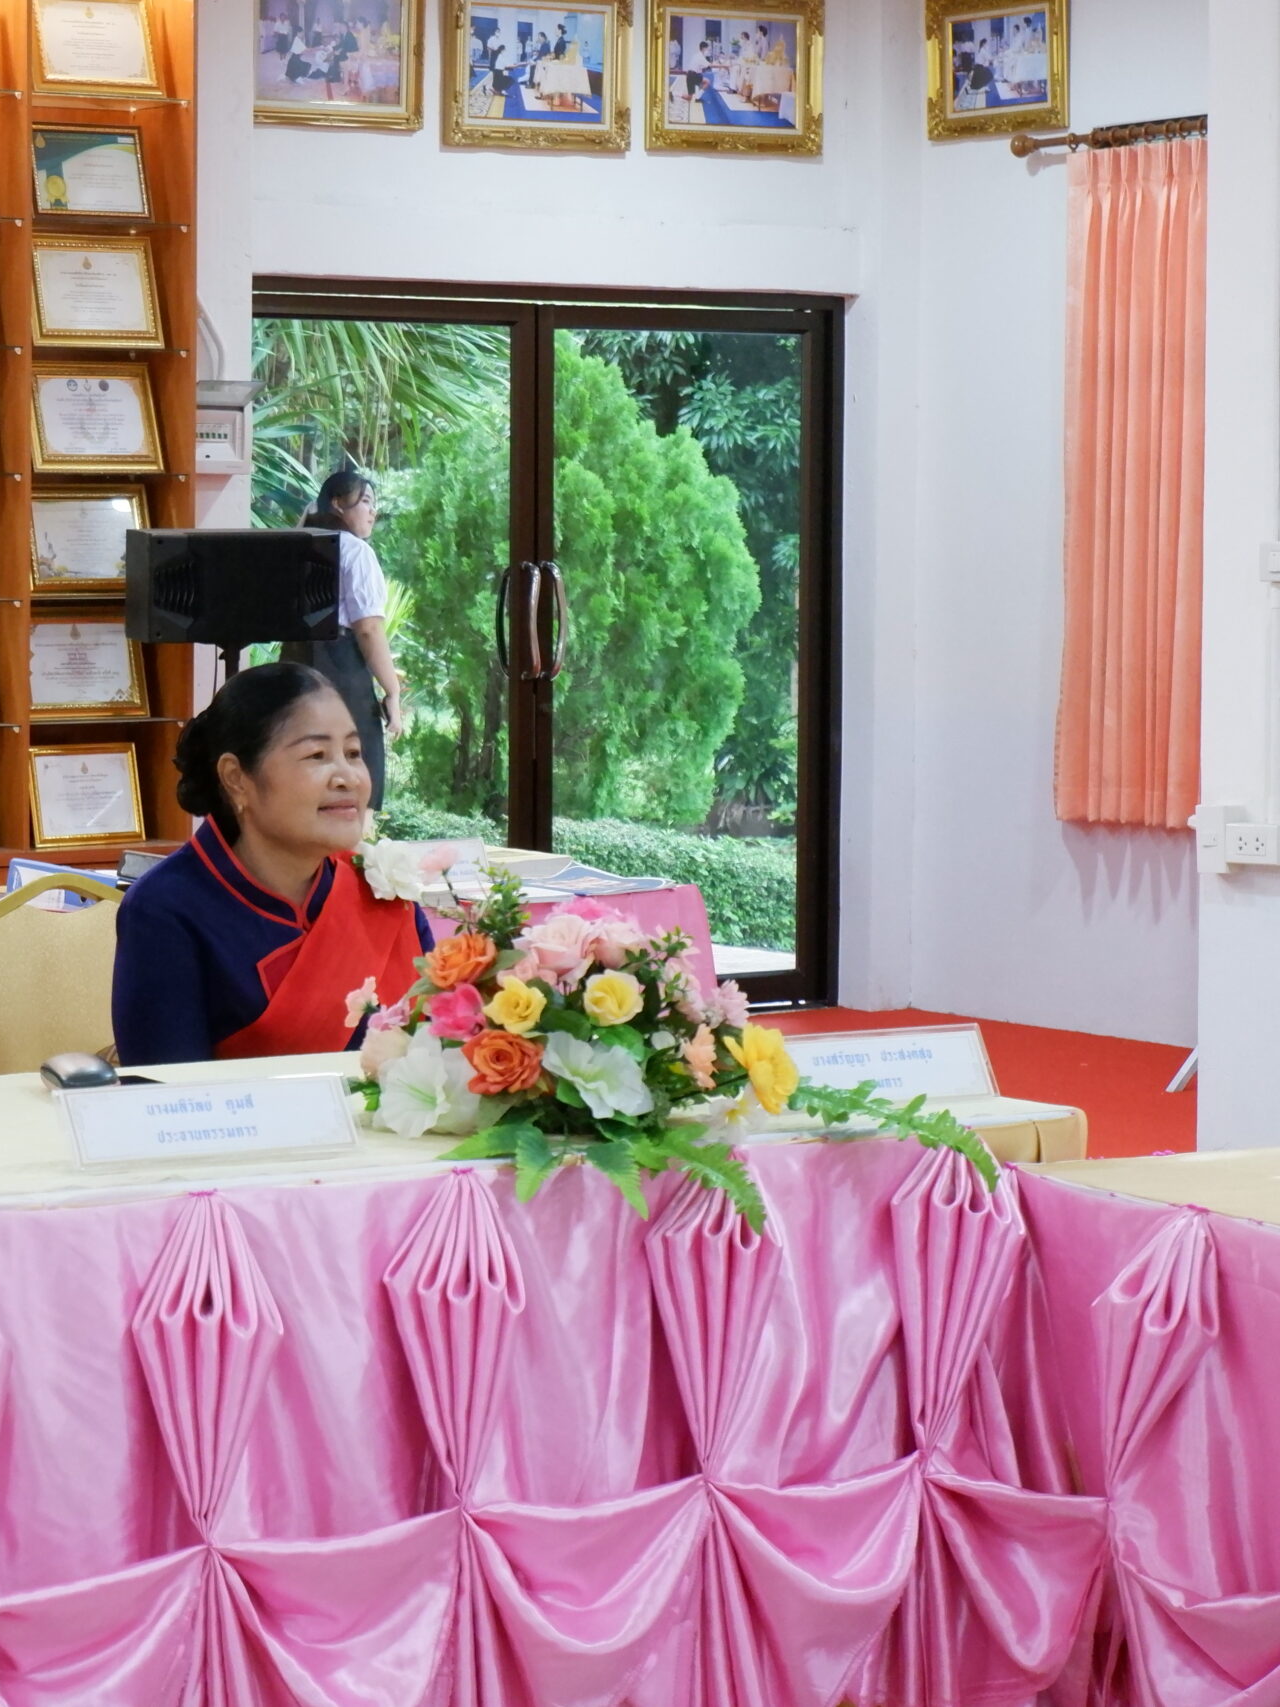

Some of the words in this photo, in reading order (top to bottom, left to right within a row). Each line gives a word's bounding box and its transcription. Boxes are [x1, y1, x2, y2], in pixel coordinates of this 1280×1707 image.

[157, 1125, 258, 1144] ประธานกรรมการ
